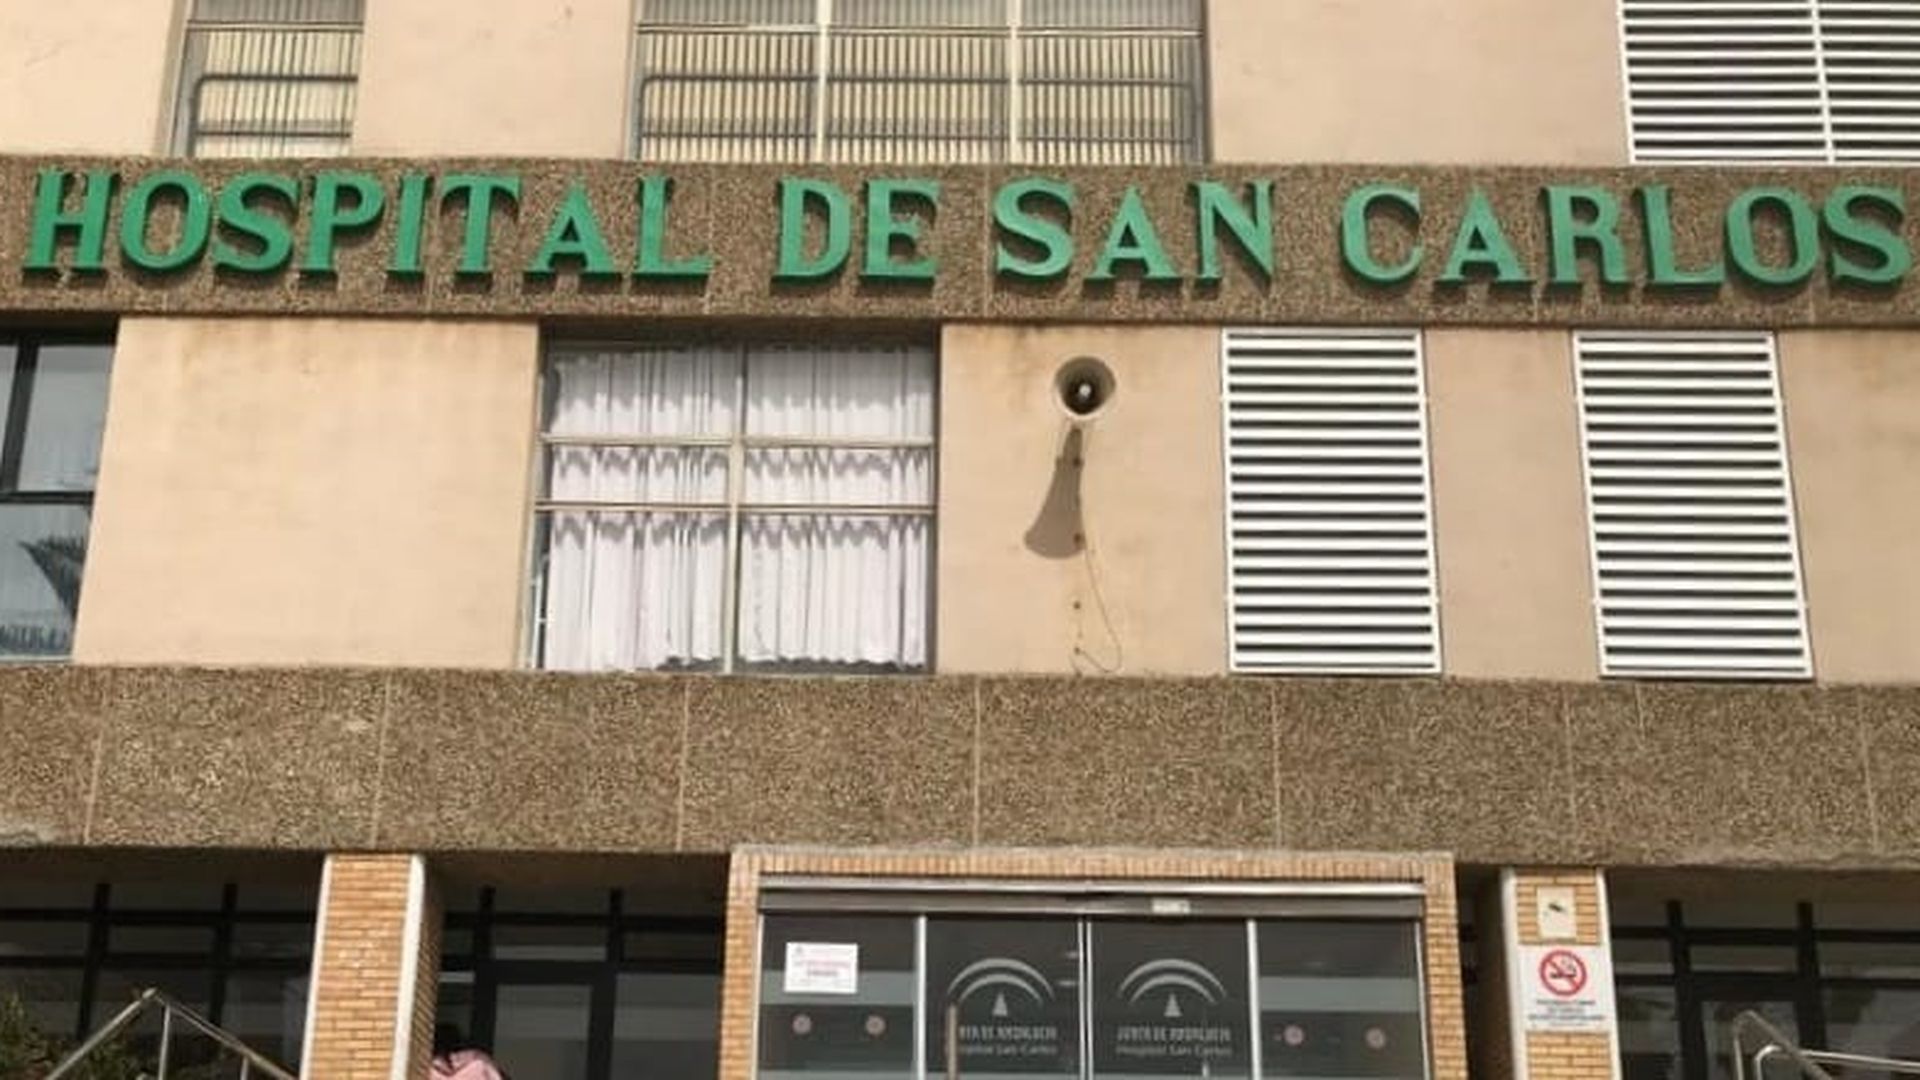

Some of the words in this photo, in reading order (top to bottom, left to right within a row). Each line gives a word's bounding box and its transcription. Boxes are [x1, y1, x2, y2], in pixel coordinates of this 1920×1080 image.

[22, 167, 713, 278] HOSPITAL
[772, 175, 942, 280] DE
[993, 176, 1276, 282] SAN
[1341, 183, 1912, 288] CARLOS
